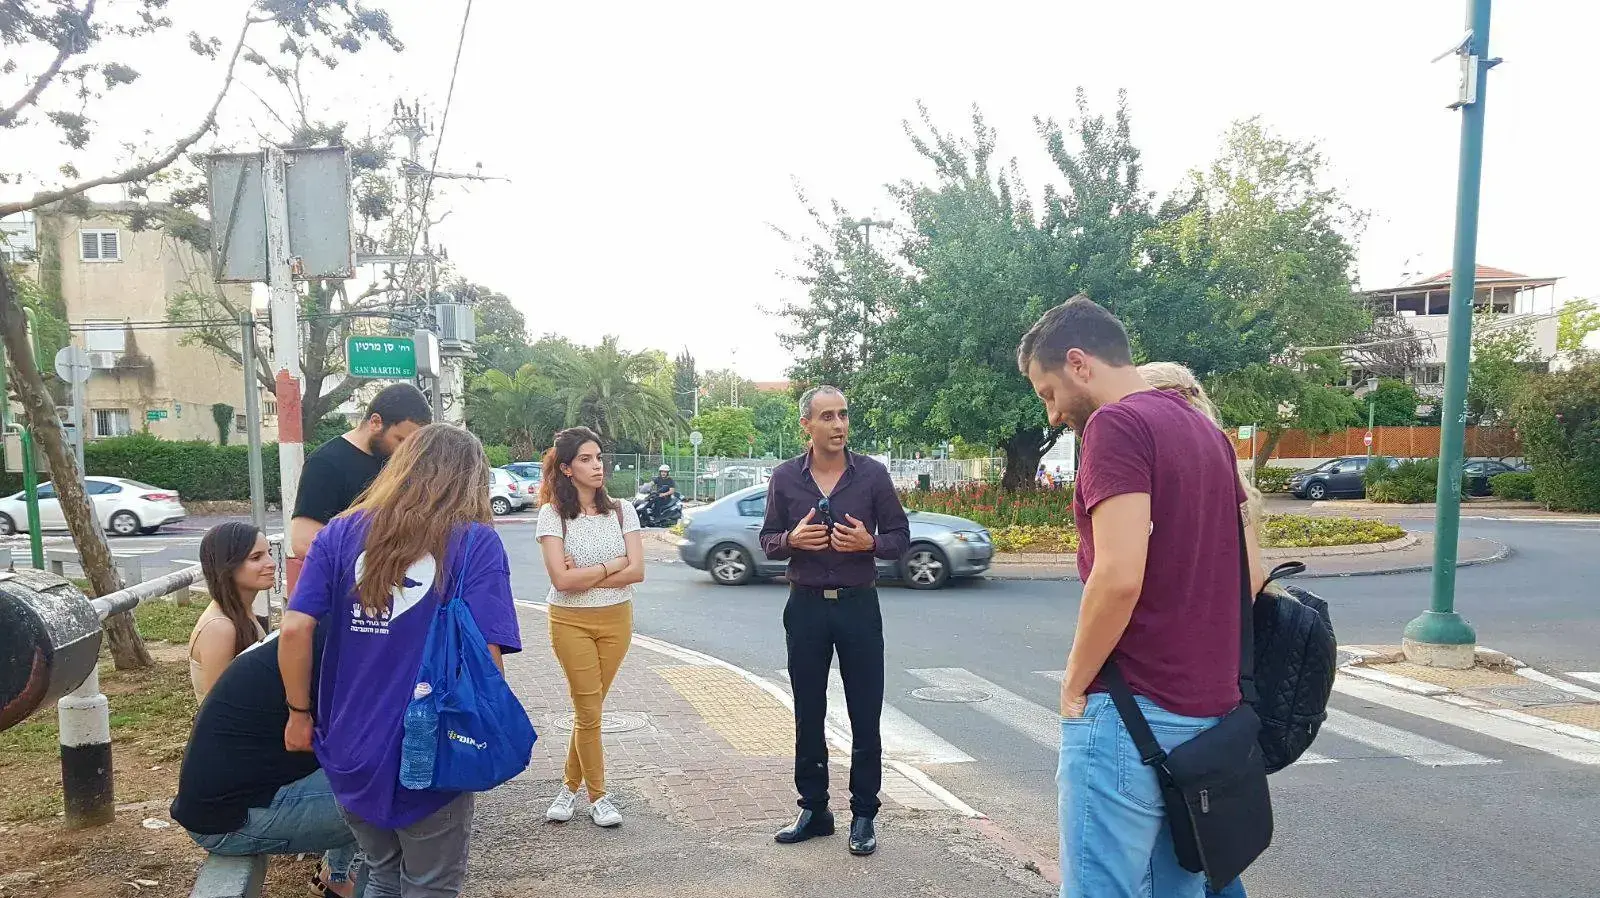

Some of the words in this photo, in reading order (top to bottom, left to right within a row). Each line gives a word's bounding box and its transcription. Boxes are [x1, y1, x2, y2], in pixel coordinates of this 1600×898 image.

[355, 342, 381, 352] מרטין
[384, 342, 394, 353] סן
[370, 366, 401, 374] MARTIN
